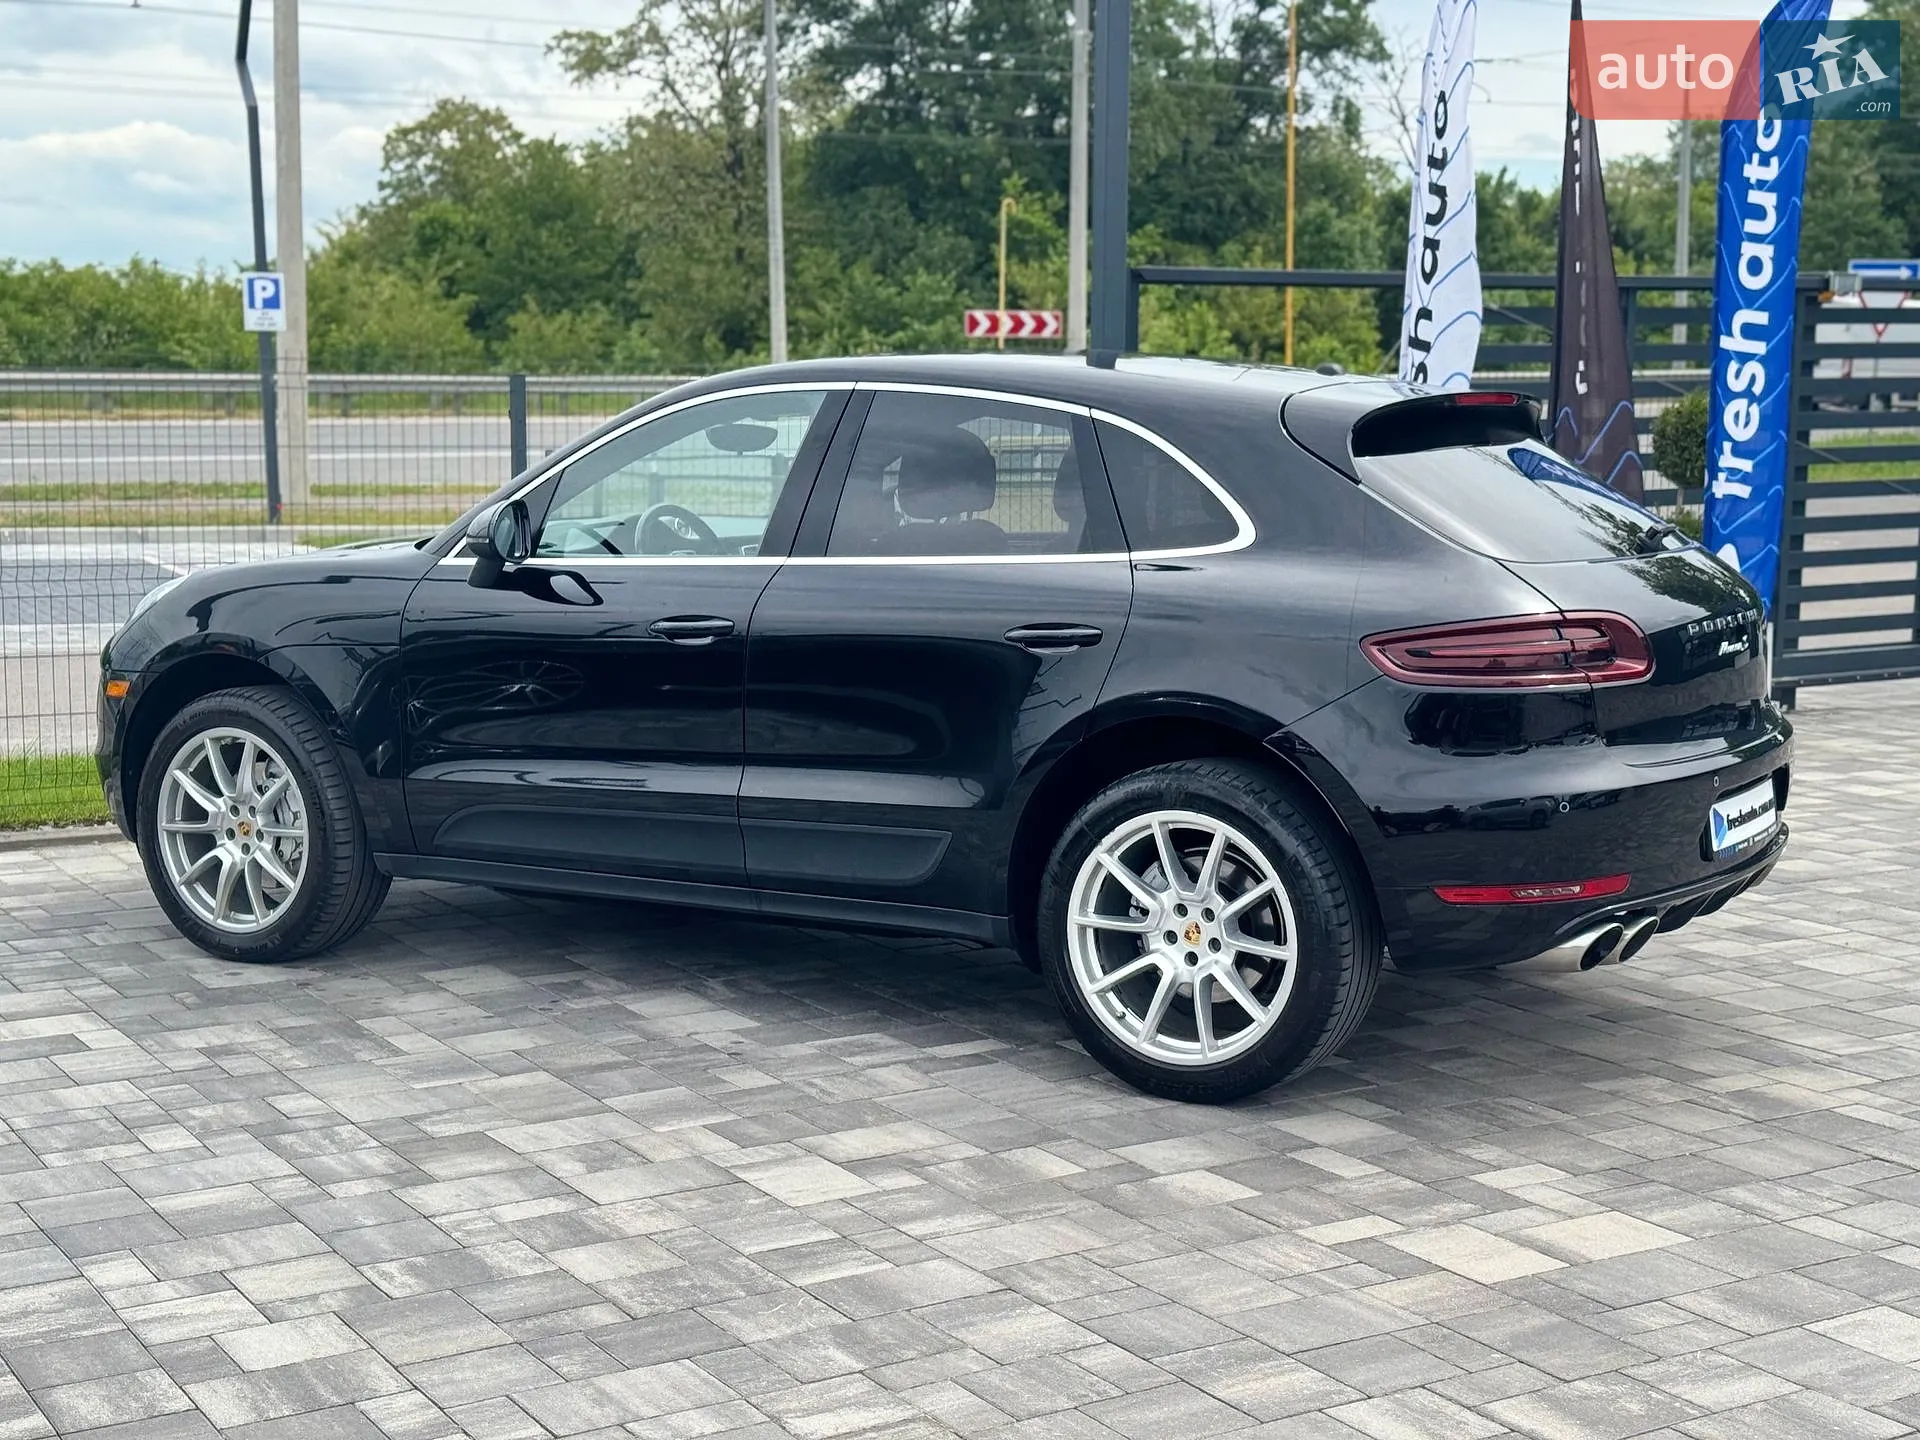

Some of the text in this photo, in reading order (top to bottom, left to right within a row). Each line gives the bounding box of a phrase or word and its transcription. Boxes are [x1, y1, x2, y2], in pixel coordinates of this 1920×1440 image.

[1420, 89, 1449, 285] auto
[253, 279, 276, 309] P
[1711, 102, 1782, 499] fresh auto
